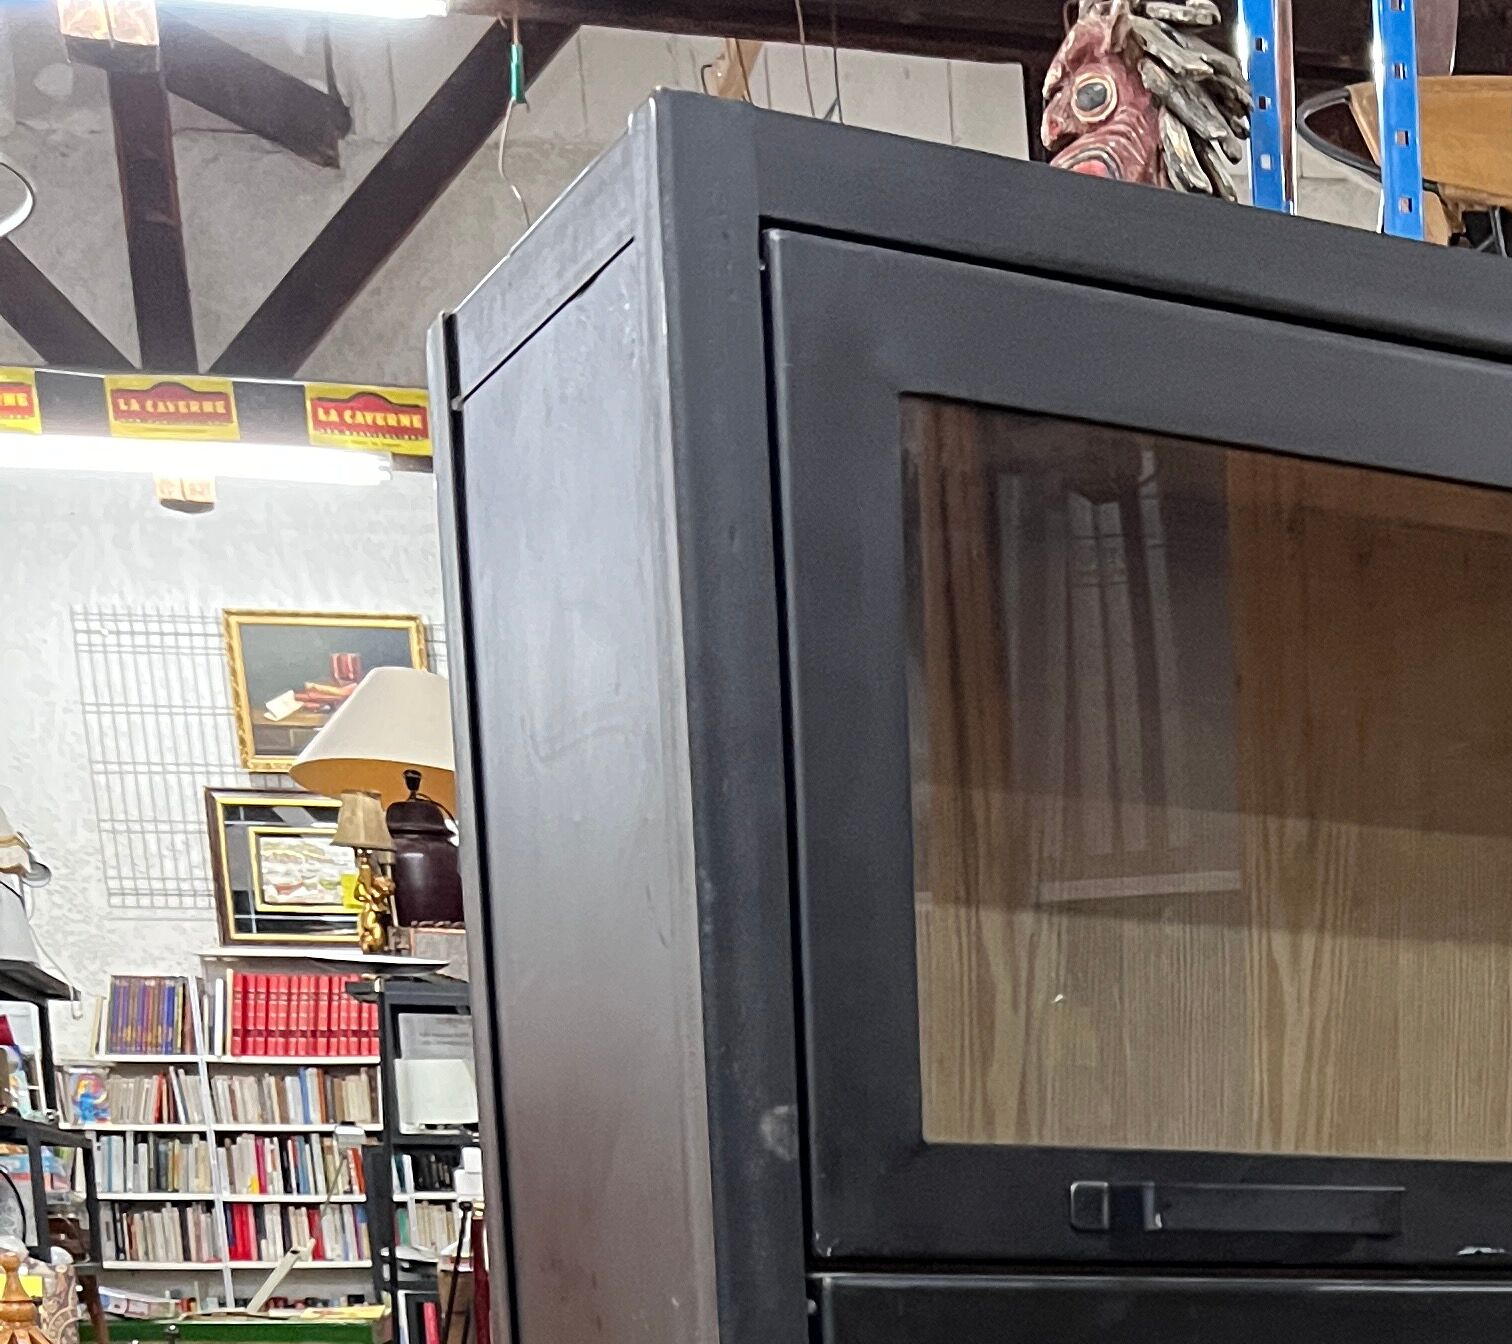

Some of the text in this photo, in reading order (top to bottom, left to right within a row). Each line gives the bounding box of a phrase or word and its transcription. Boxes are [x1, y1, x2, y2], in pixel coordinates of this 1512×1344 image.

[118, 398, 226, 413] LA CAVERNE
[317, 407, 423, 429] LA CAVERNE
